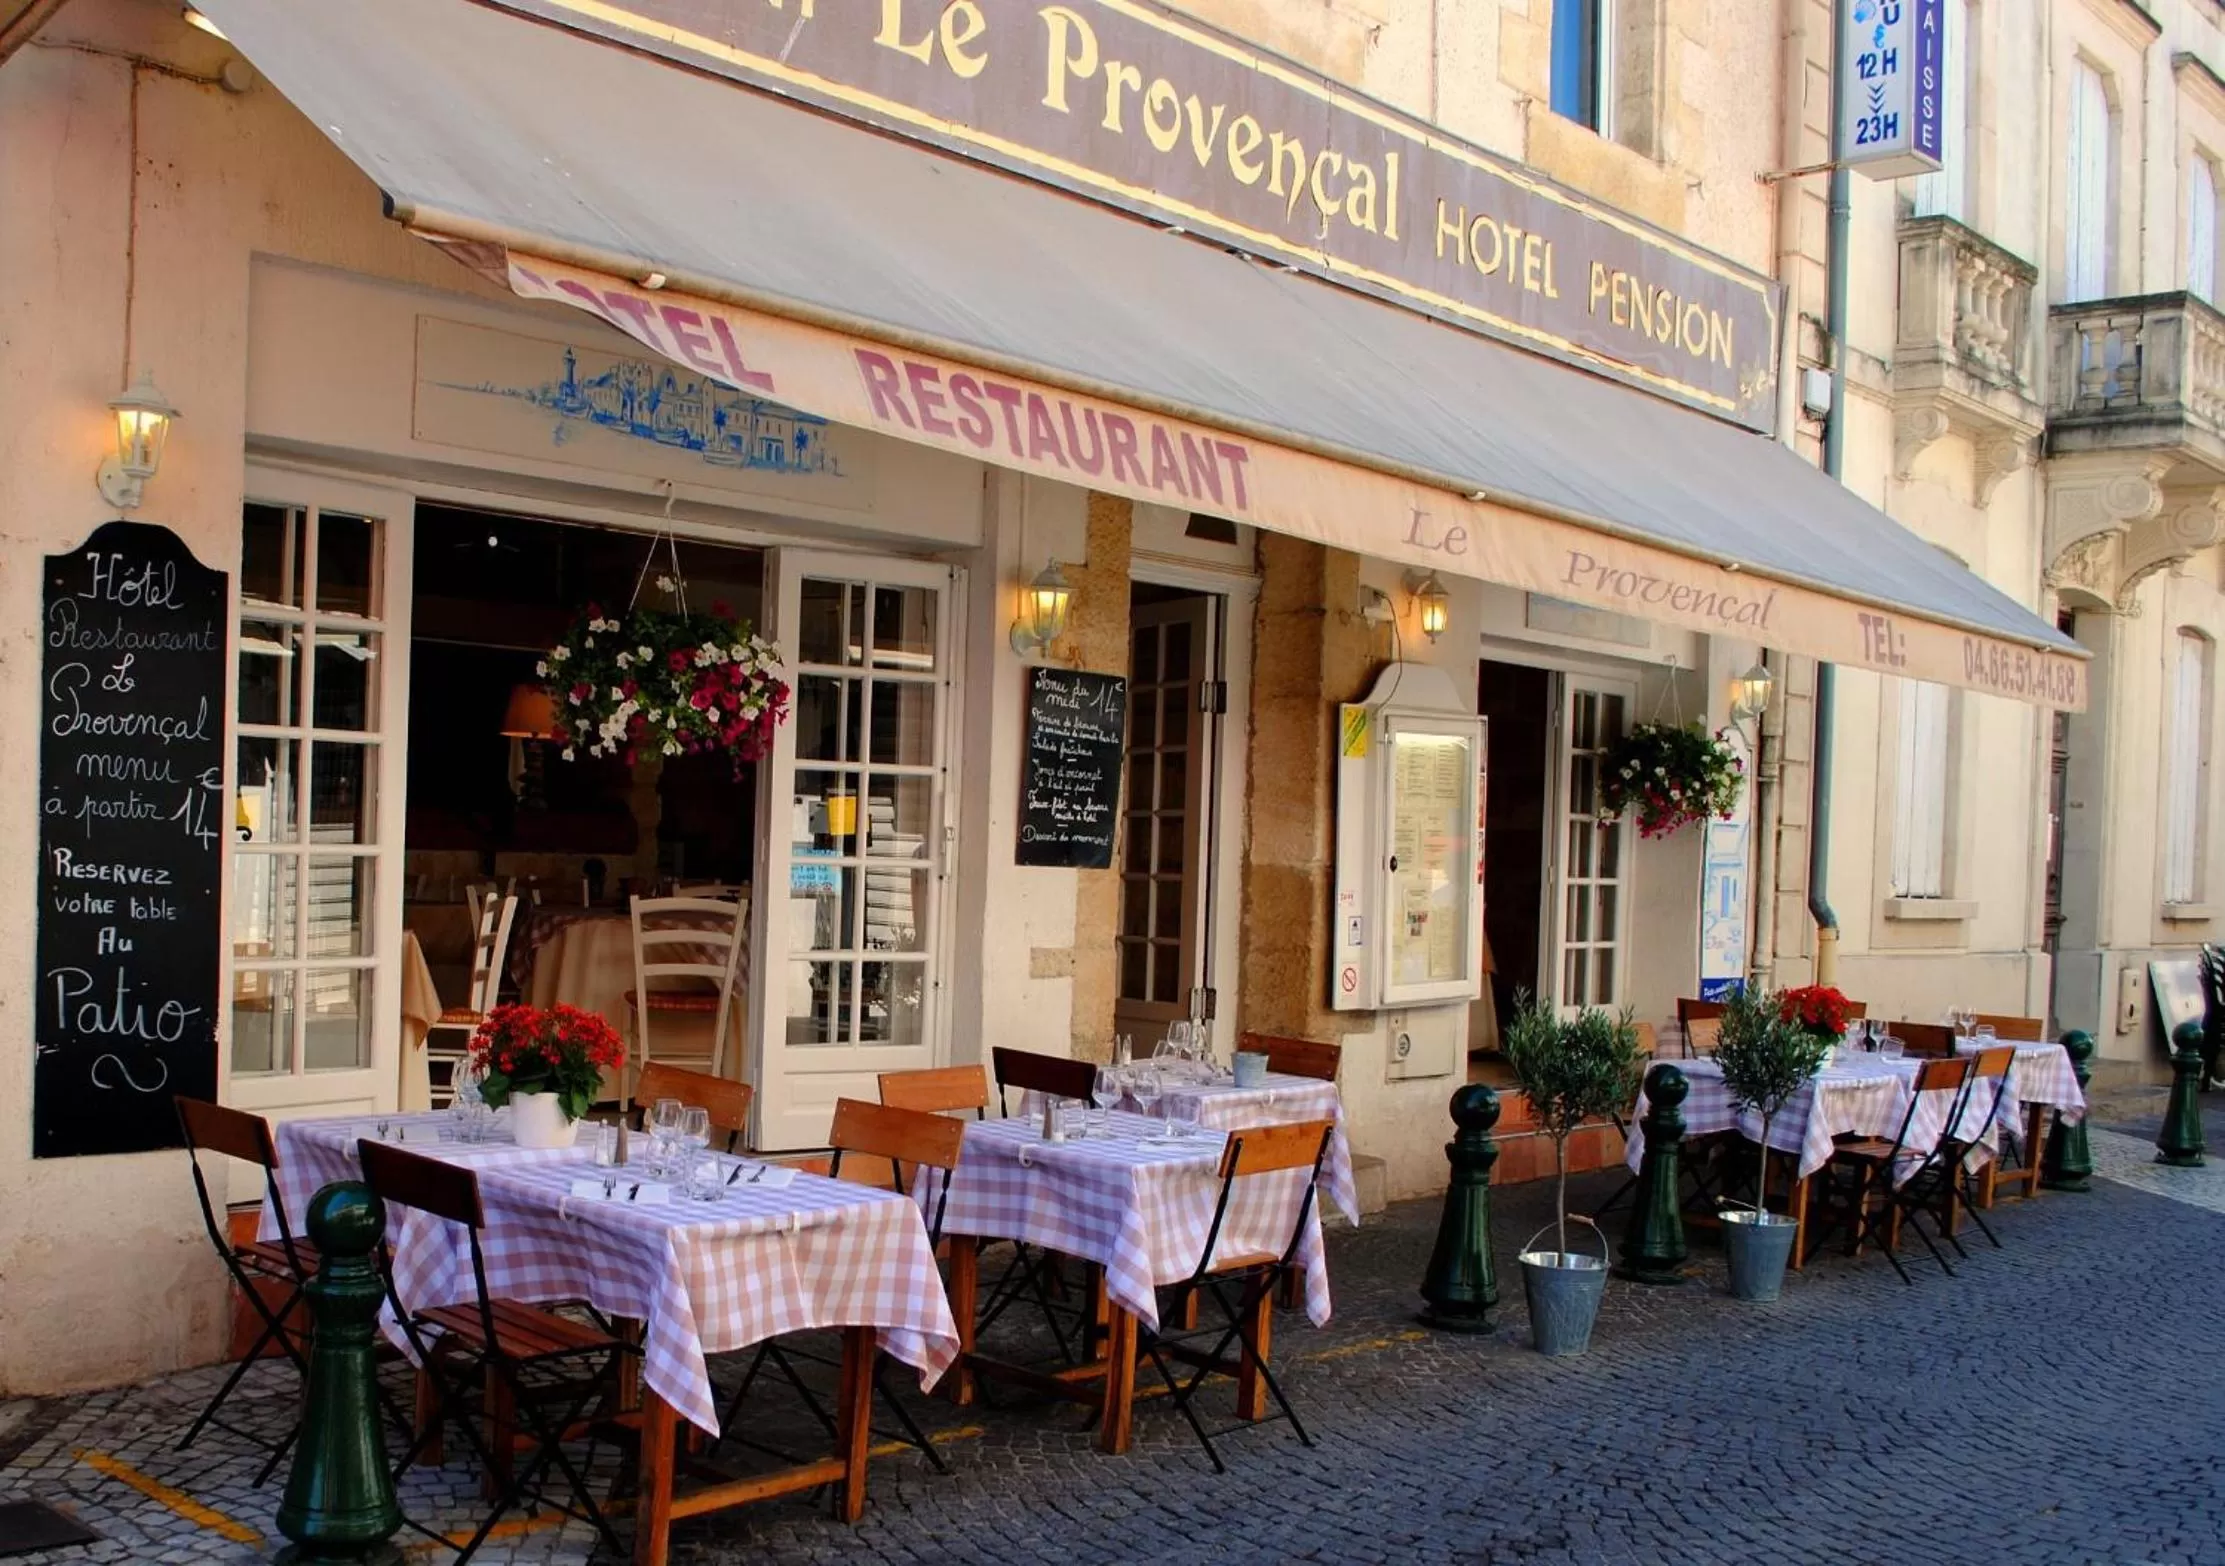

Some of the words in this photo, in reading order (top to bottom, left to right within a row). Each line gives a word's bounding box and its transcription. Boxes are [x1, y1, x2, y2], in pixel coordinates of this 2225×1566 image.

[1922, 0, 1935, 148] AISSE
[1856, 112, 1898, 145] 23H
[875, 0, 988, 77] Le
[1039, 6, 1400, 241] Provençal
[1436, 197, 1559, 299] HOTEL
[1588, 260, 1734, 369] PENSION
[517, 264, 775, 393] TEL
[854, 348, 1248, 511] RESTAURANT
[1402, 508, 1469, 557] Le
[1561, 549, 1776, 632] Provençal
[78, 552, 184, 609] Hôtel
[50, 598, 219, 651] Restaurant
[51, 663, 211, 744] Provençal
[1089, 682, 1119, 722] 14
[77, 753, 180, 783] menu
[75, 790, 165, 839] partir
[171, 788, 218, 851] 14
[47, 966, 201, 1042] Patio
